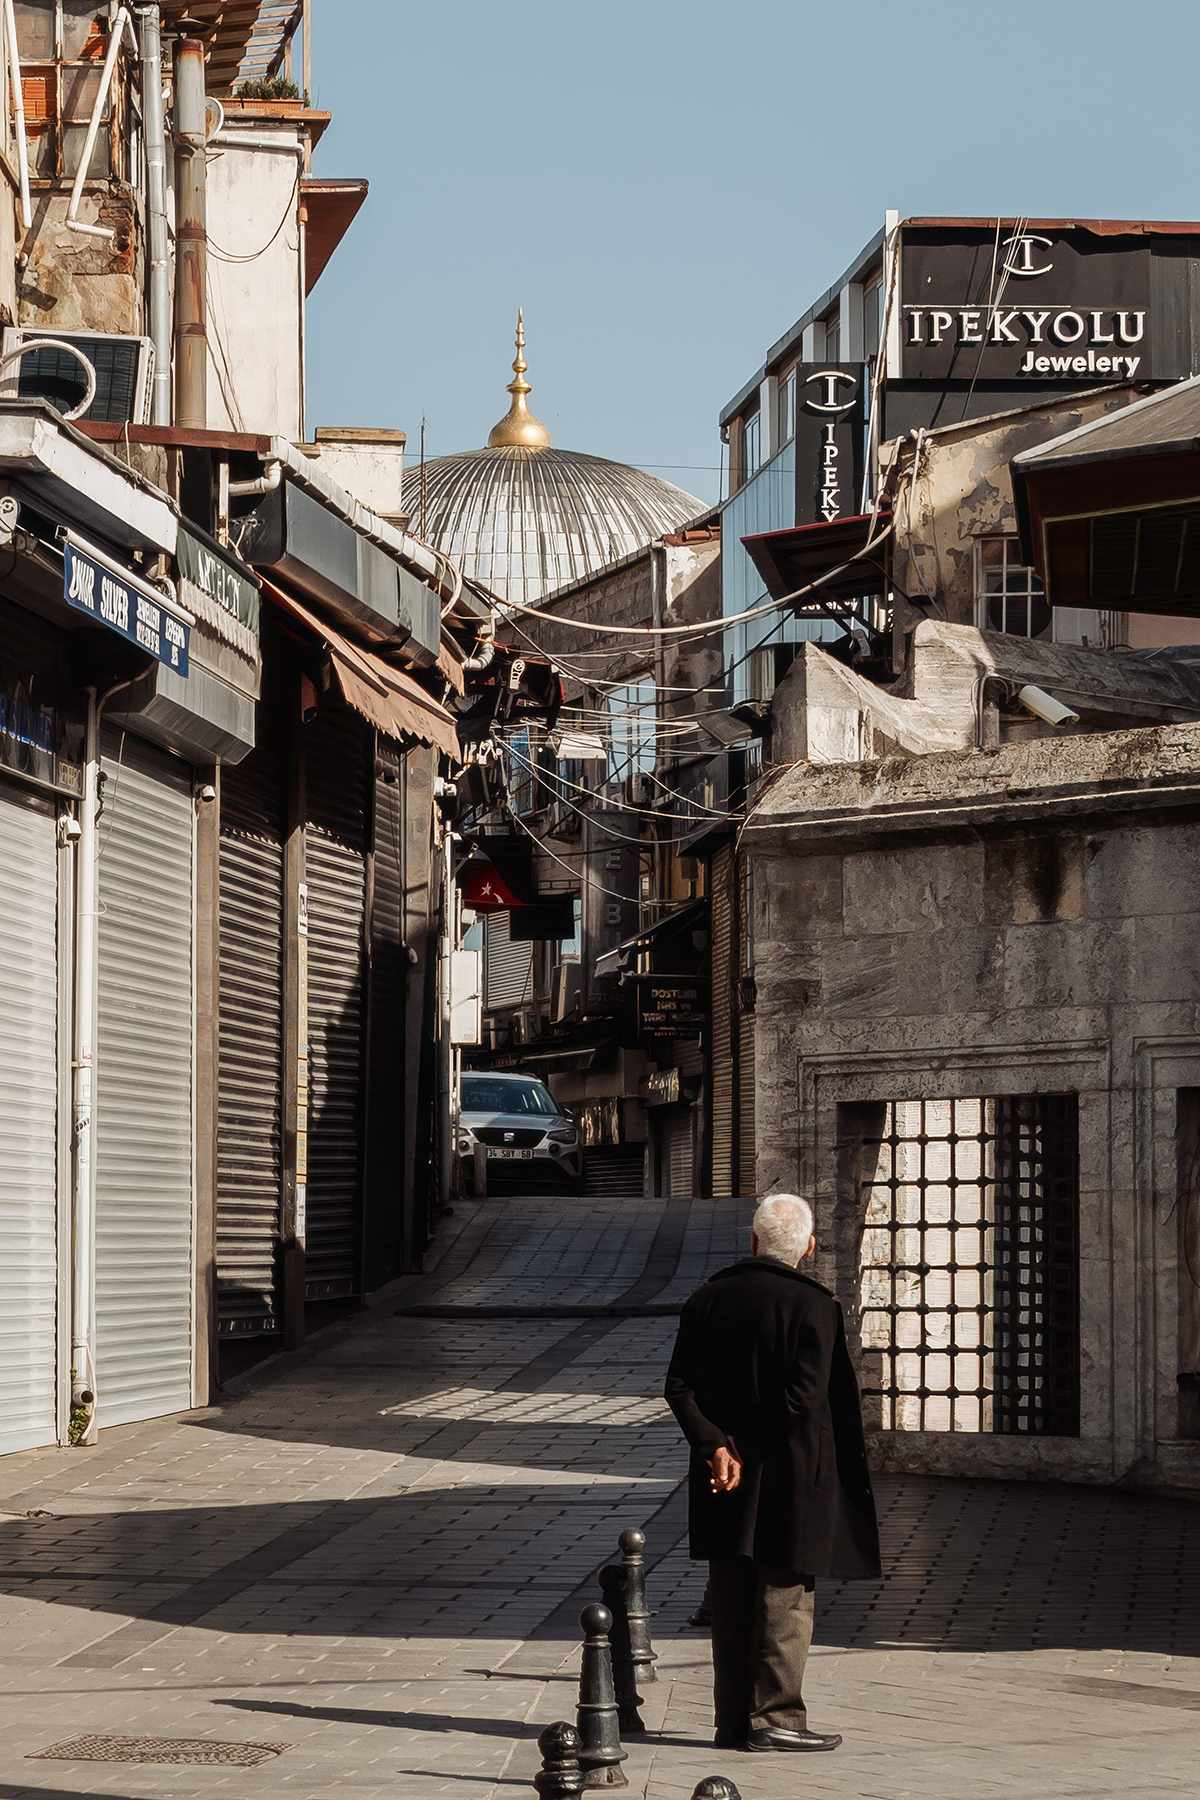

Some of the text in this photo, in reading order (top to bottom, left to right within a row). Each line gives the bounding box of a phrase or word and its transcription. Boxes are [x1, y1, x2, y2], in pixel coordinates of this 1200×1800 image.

[910, 311, 1146, 343] IPEKYOLU
[1021, 350, 1141, 378] Jewelery
[100, 575, 129, 632] SILVER
[488, 1149, 497, 1157] 34
